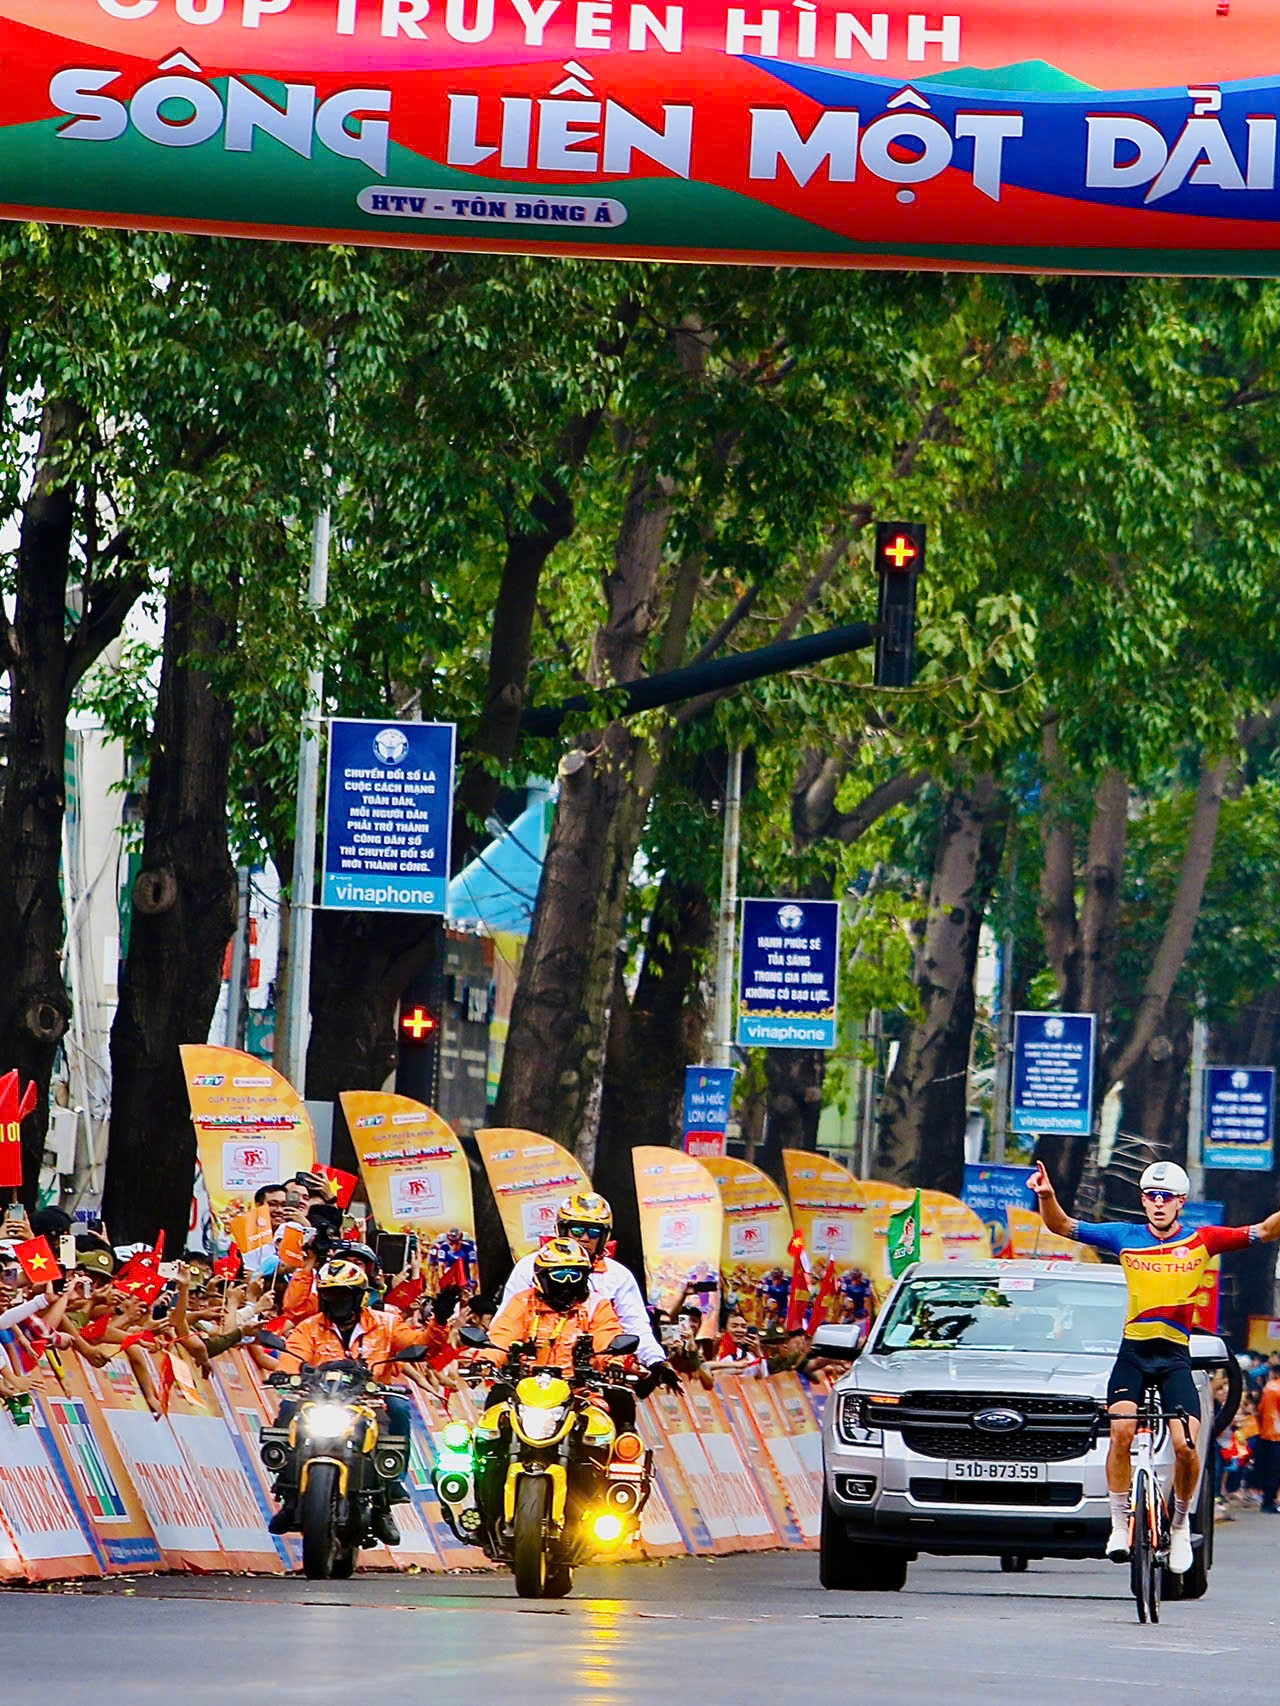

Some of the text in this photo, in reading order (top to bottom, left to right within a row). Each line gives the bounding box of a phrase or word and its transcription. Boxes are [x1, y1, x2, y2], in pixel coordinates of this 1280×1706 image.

[48, 47, 1277, 204] SÔNG LIỀN MỘT DẢI
[371, 194, 428, 213] HTV
[452, 196, 507, 218] TÔN
[515, 199, 586, 222] ĐÔNG
[594, 202, 612, 223] Á
[406, 769, 421, 781] SỐ
[423, 770, 436, 781] LÀ
[344, 781, 435, 795] CUỘC CÁCH MẠNG
[362, 795, 389, 805] TOÀN
[347, 819, 371, 830] PHẢI
[395, 822, 430, 833] THÀNH
[353, 833, 382, 844] CÔNG
[407, 834, 422, 846] SỐ
[339, 845, 356, 856] THÌ
[420, 847, 435, 859] SỐ
[364, 860, 398, 871] THÀNH
[336, 884, 435, 905] vinaphone
[748, 1025, 825, 1042] vinaphone
[955, 1462, 1039, 1479] 51D-873.59
